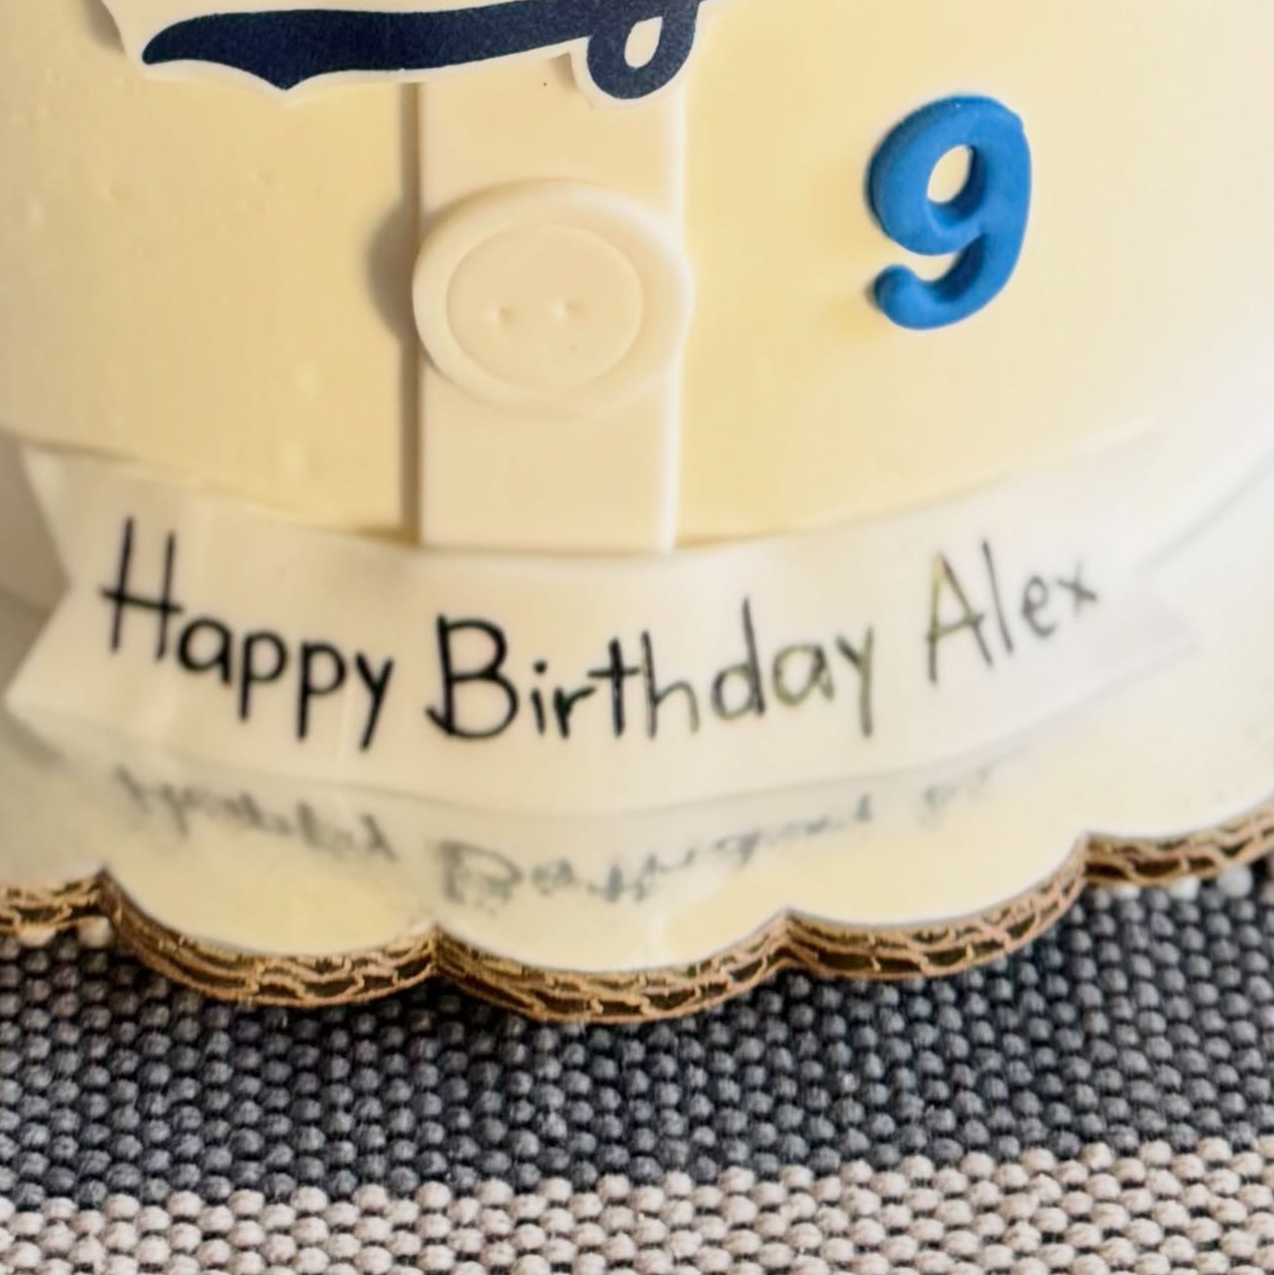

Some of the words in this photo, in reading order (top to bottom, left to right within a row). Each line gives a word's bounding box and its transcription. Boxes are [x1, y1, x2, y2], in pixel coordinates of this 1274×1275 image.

[866, 93, 1033, 330] 9
[99, 517, 395, 751] Happy
[424, 597, 876, 740] Birthday
[924, 540, 1101, 685] Alex
